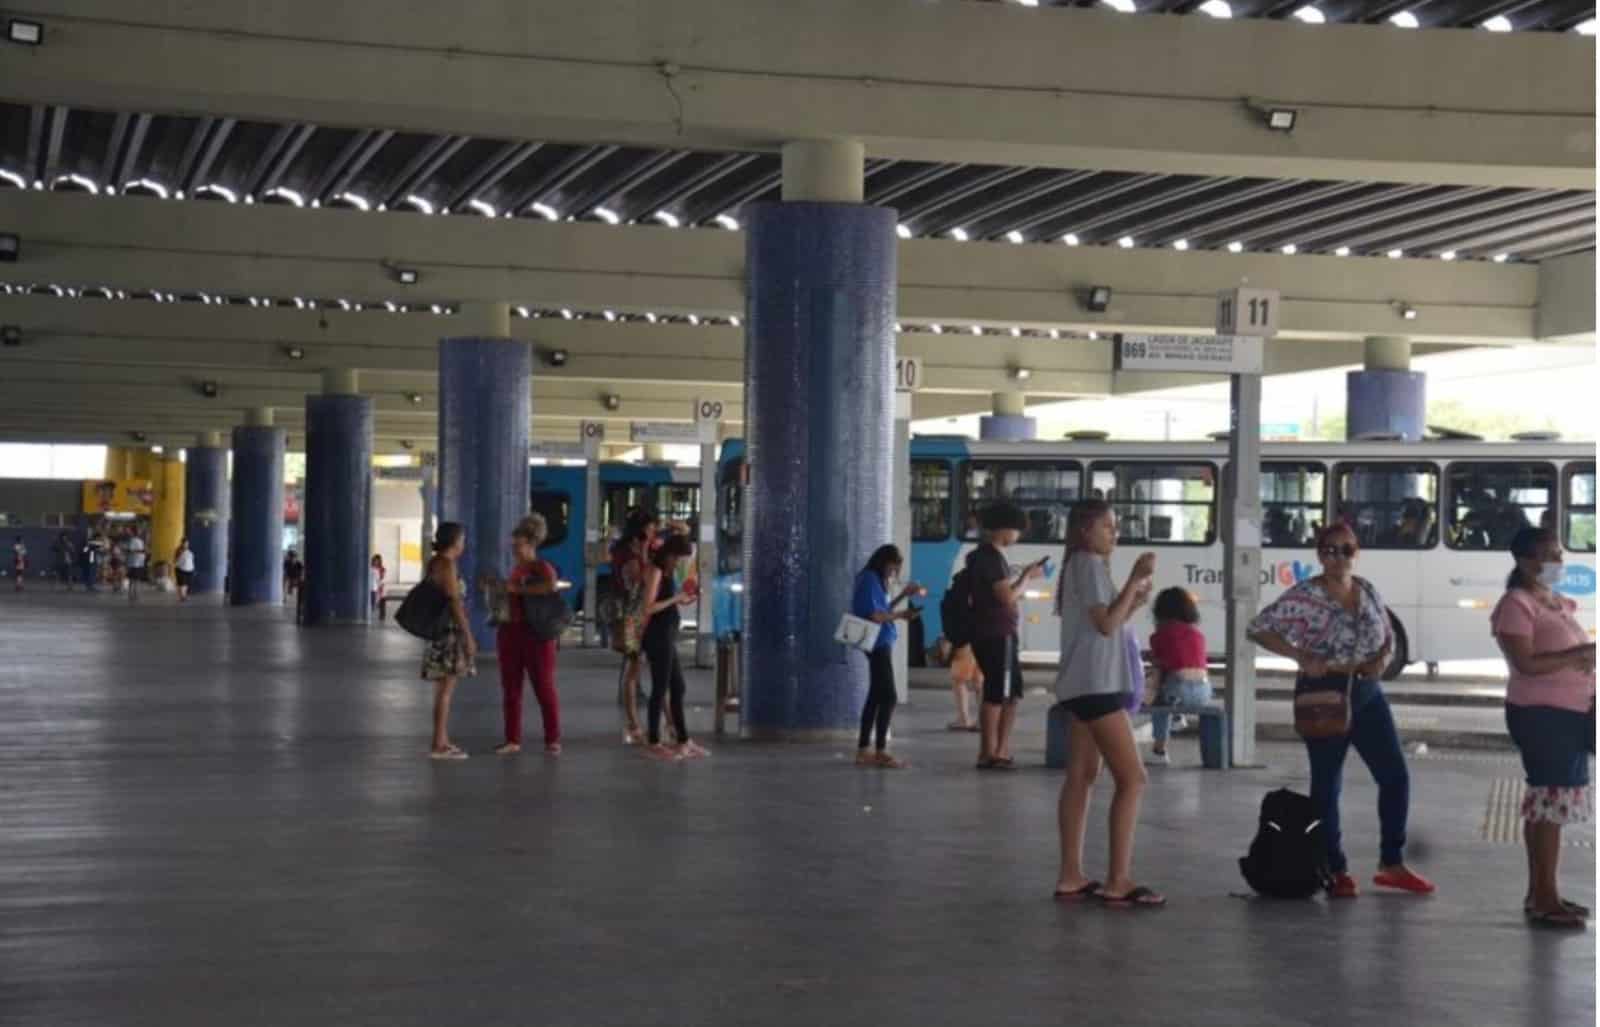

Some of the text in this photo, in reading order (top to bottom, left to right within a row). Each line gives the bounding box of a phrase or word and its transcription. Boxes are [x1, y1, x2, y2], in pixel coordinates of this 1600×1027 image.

[1248, 297, 1270, 326] 11
[1122, 341, 1146, 359] 869
[896, 359, 917, 387] 10
[700, 400, 723, 418] 09
